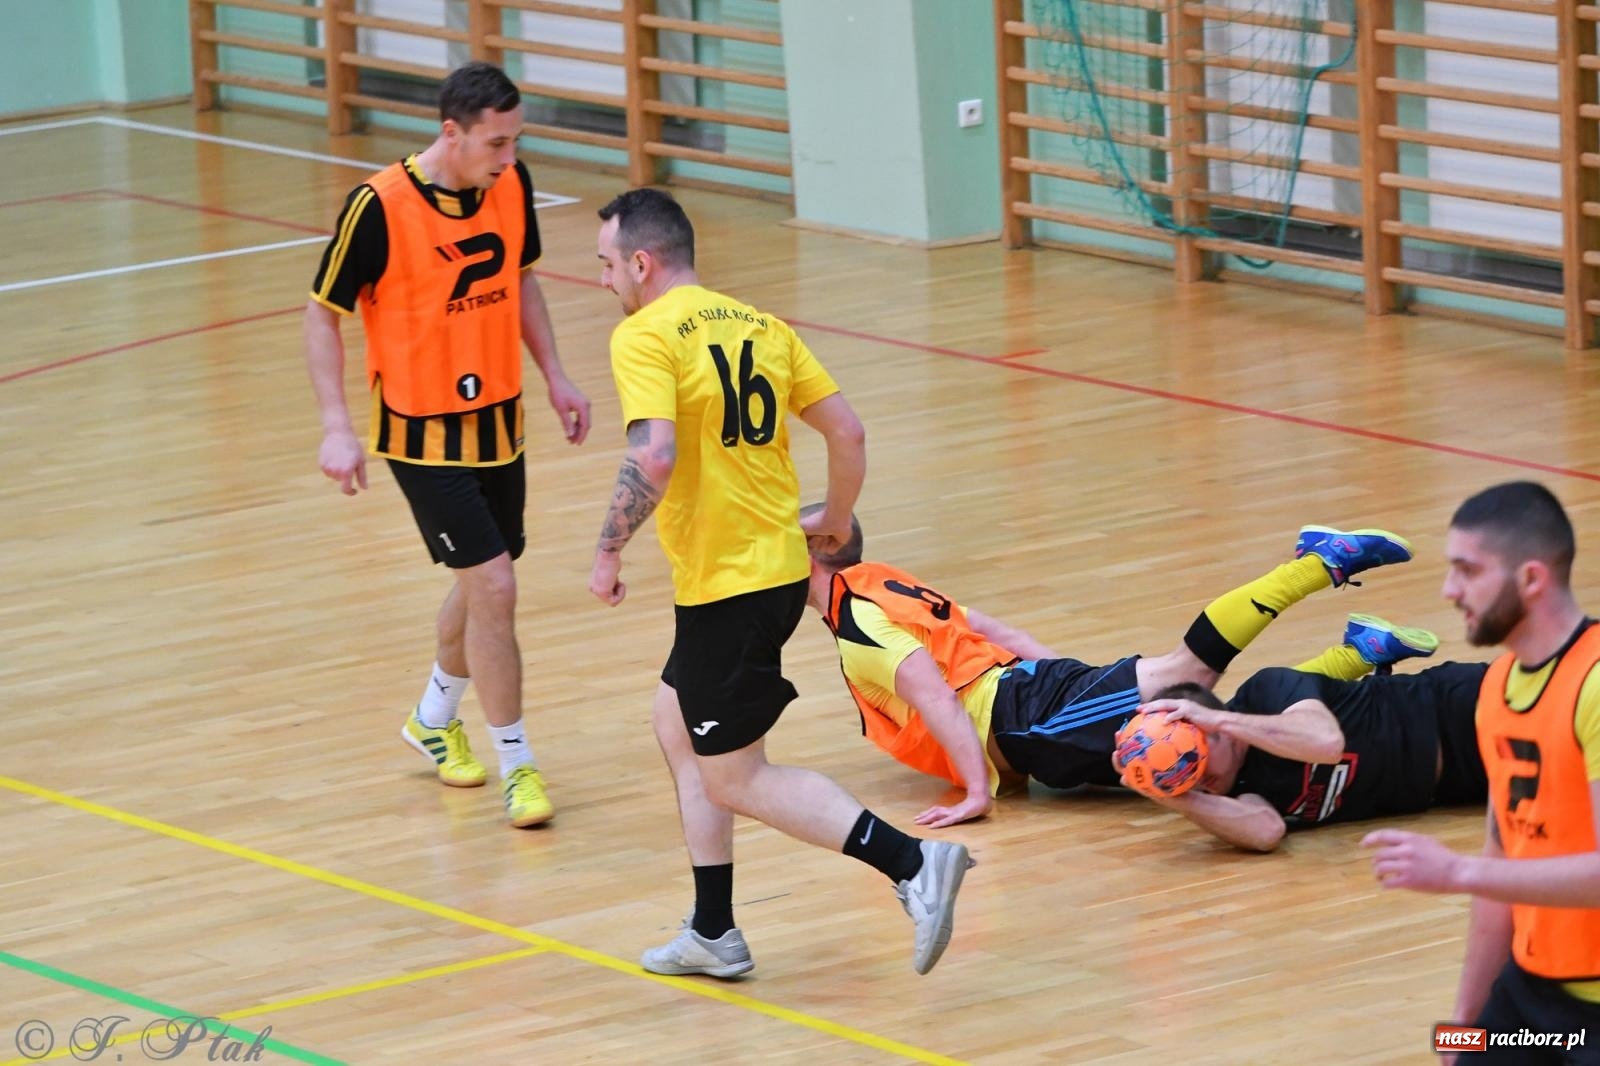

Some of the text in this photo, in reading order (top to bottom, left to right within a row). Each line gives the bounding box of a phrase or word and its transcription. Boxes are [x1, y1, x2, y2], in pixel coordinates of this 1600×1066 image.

[446, 286, 509, 316] PATRICK
[462, 376, 476, 398] 1
[708, 340, 777, 447] 16
[438, 532, 456, 552] 1
